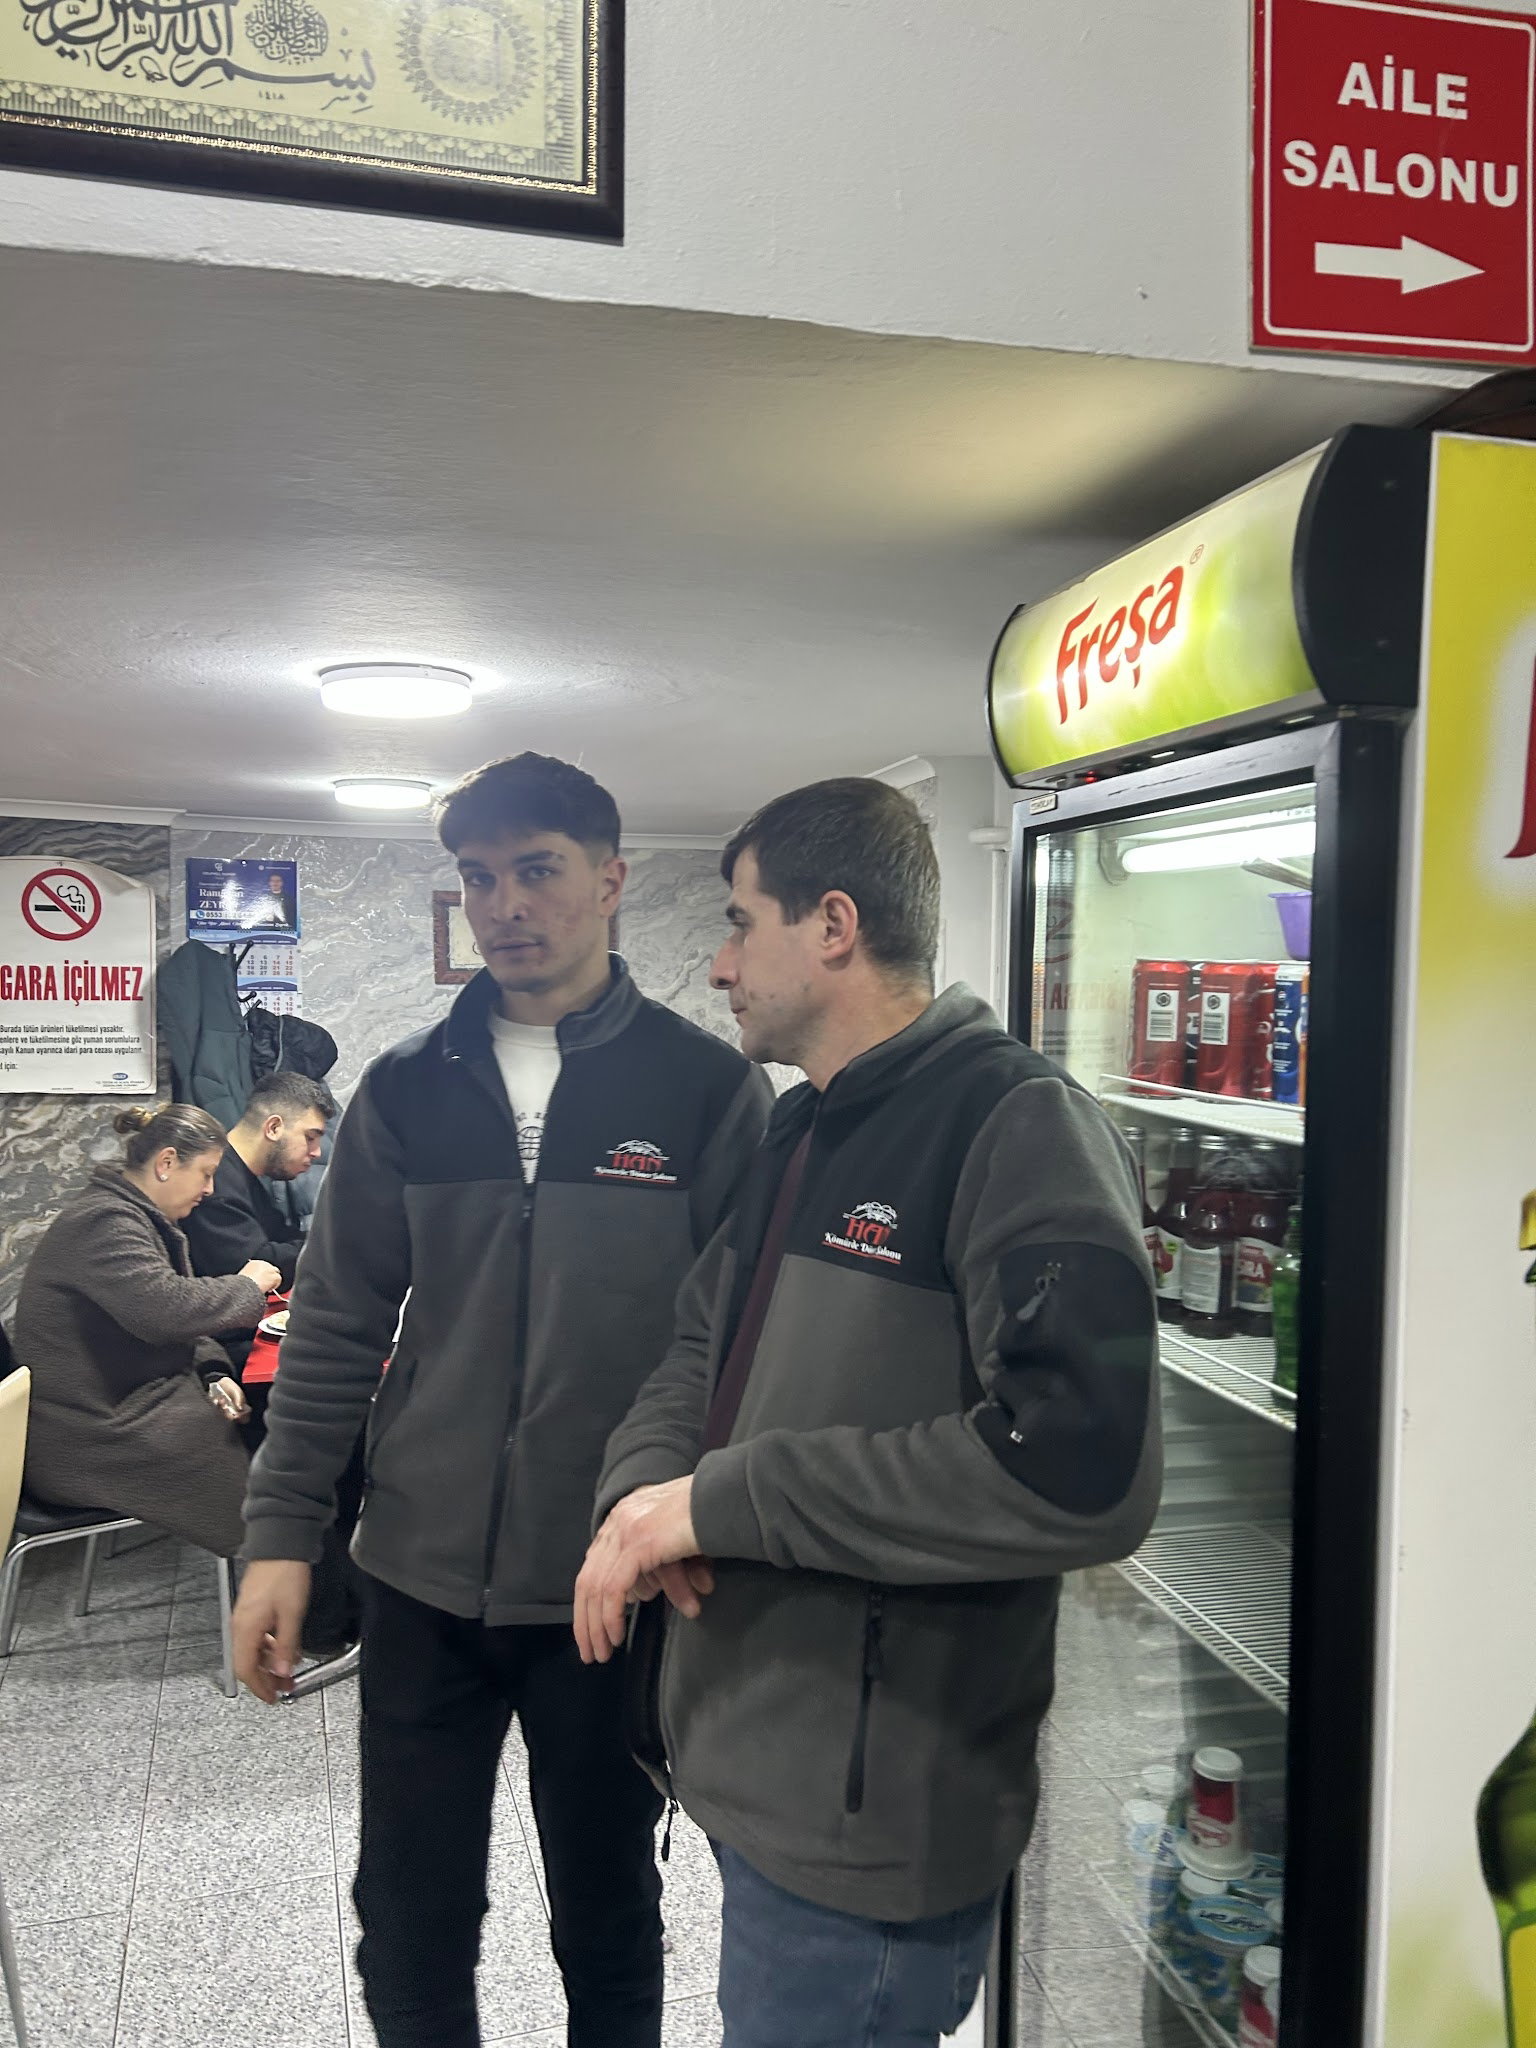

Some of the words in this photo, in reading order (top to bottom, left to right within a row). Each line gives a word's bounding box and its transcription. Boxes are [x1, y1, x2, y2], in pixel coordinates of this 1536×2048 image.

[1336, 53, 1469, 121] AİLE
[1281, 138, 1520, 208] SALONU
[1055, 564, 1185, 726] Freşa
[0, 965, 58, 1001] GARA
[63, 959, 144, 1006] İÇİLMEZ
[15, 1046, 35, 1054] Kanun
[79, 1047, 93, 1055] para
[20, 1036, 28, 1044] ve
